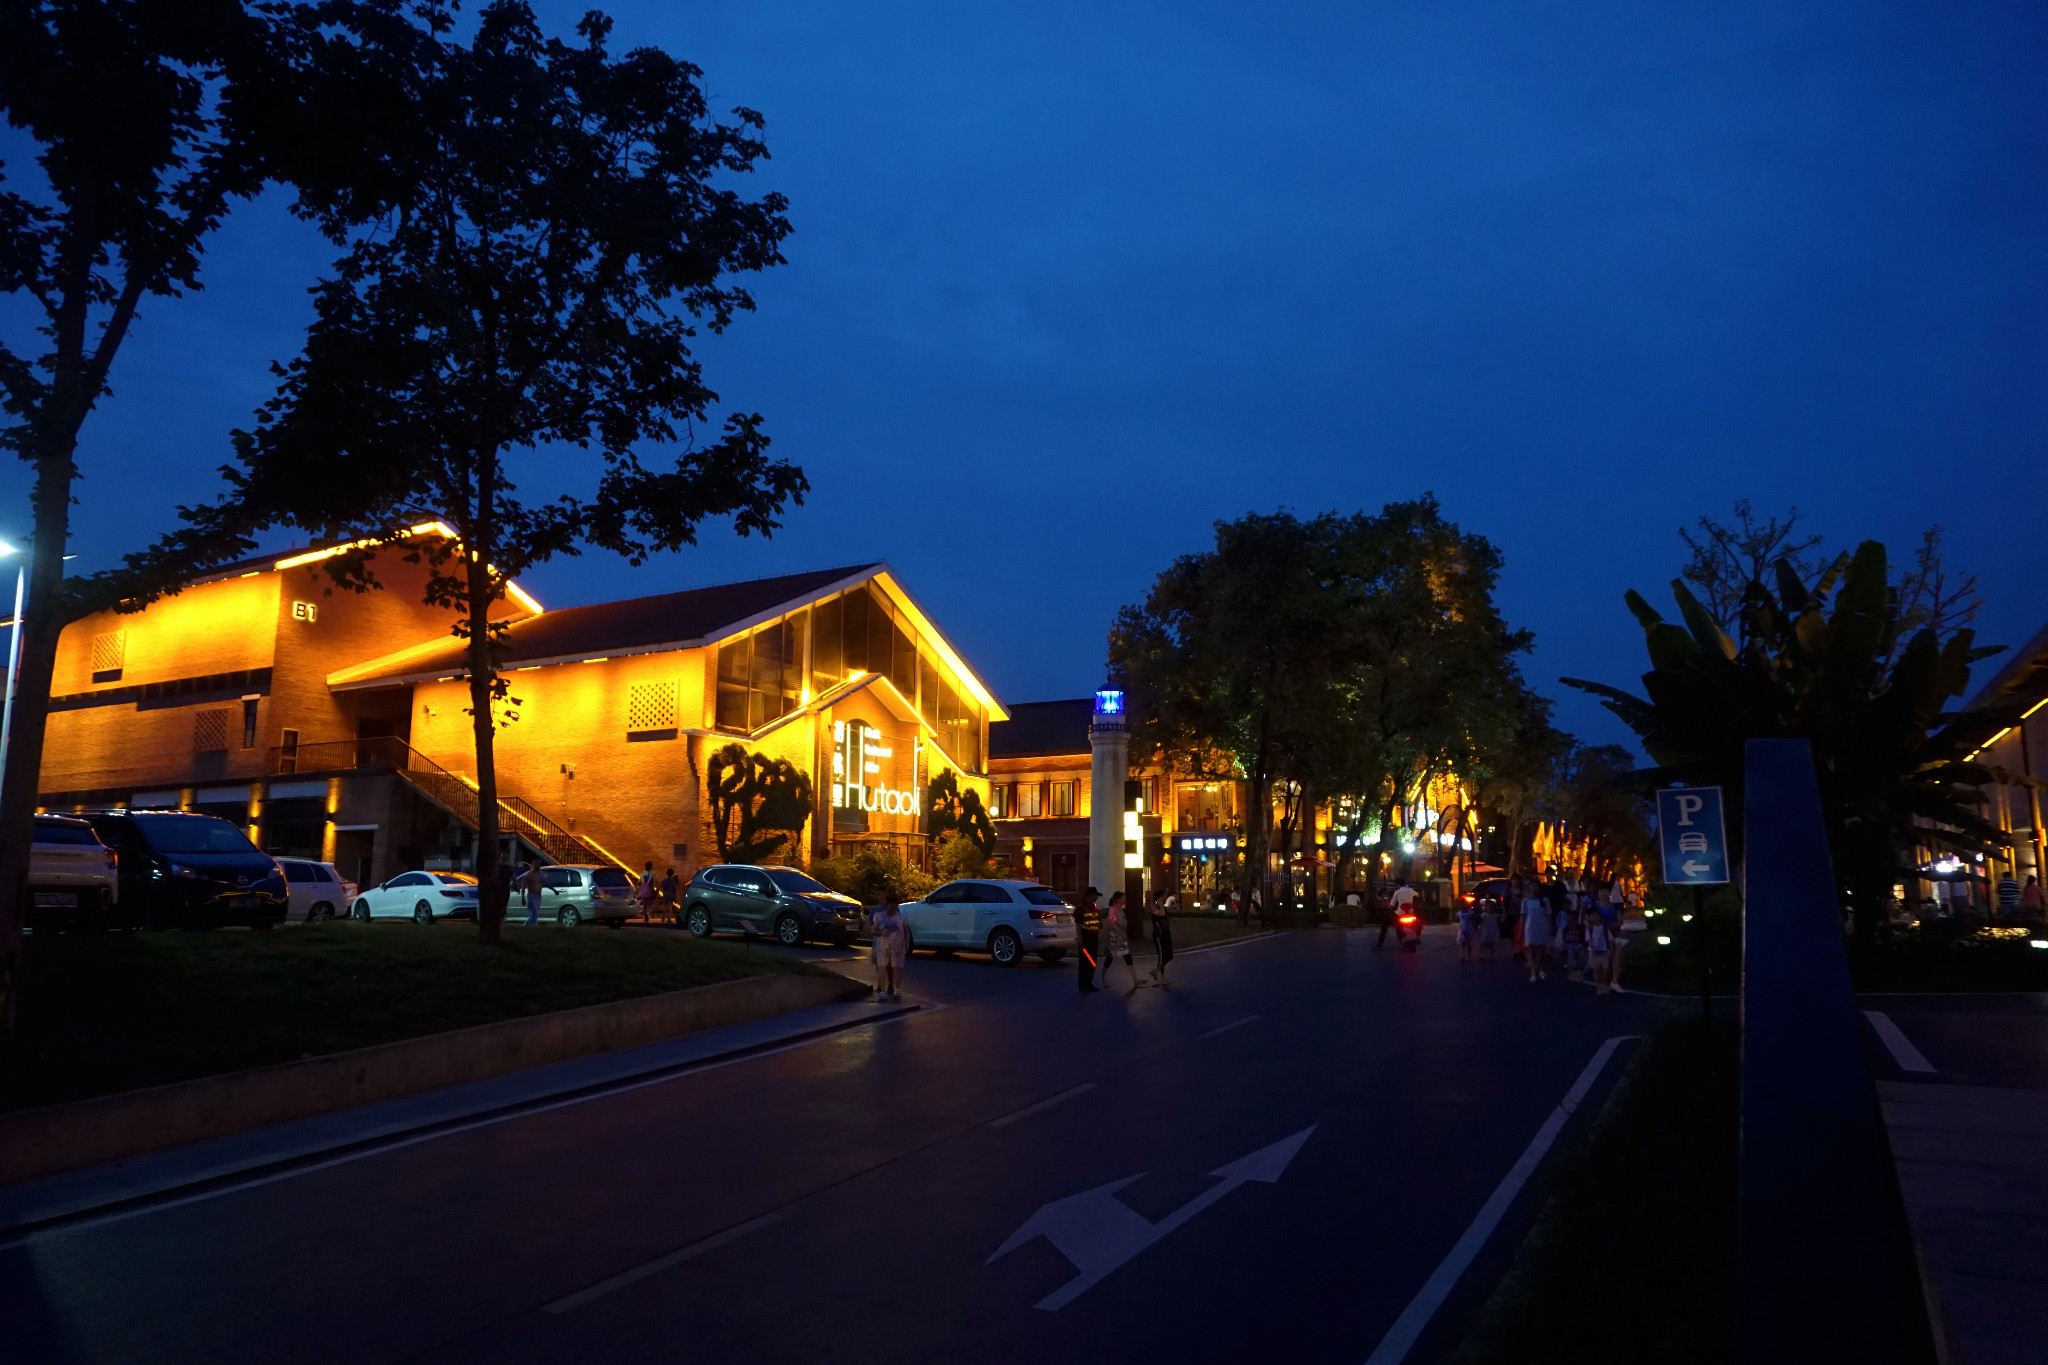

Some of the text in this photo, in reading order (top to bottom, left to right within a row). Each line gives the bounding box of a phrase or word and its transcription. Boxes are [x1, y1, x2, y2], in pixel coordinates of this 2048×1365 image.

[293, 601, 316, 622] B1
[845, 723, 921, 817] Hutaoli
[1675, 795, 1703, 826] P
